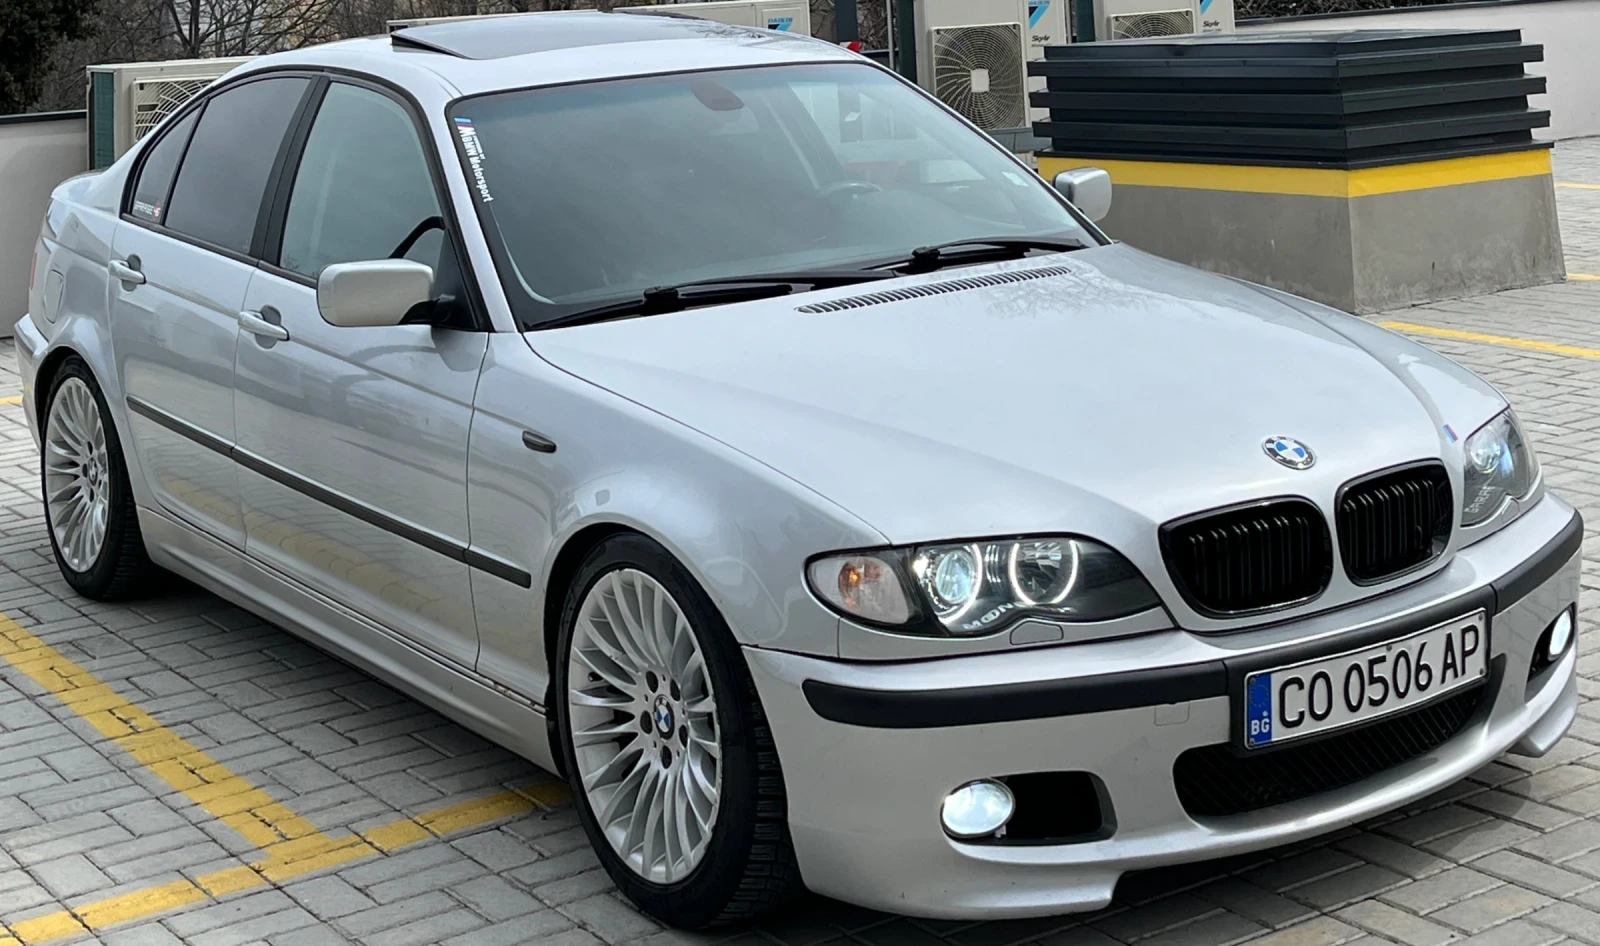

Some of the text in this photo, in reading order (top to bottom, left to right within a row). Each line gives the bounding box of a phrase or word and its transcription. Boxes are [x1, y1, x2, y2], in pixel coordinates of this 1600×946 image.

[462, 136, 494, 203] BMW Motorsport
[1279, 624, 1479, 729] CO 0506 AP
[1251, 719, 1270, 735] BG
